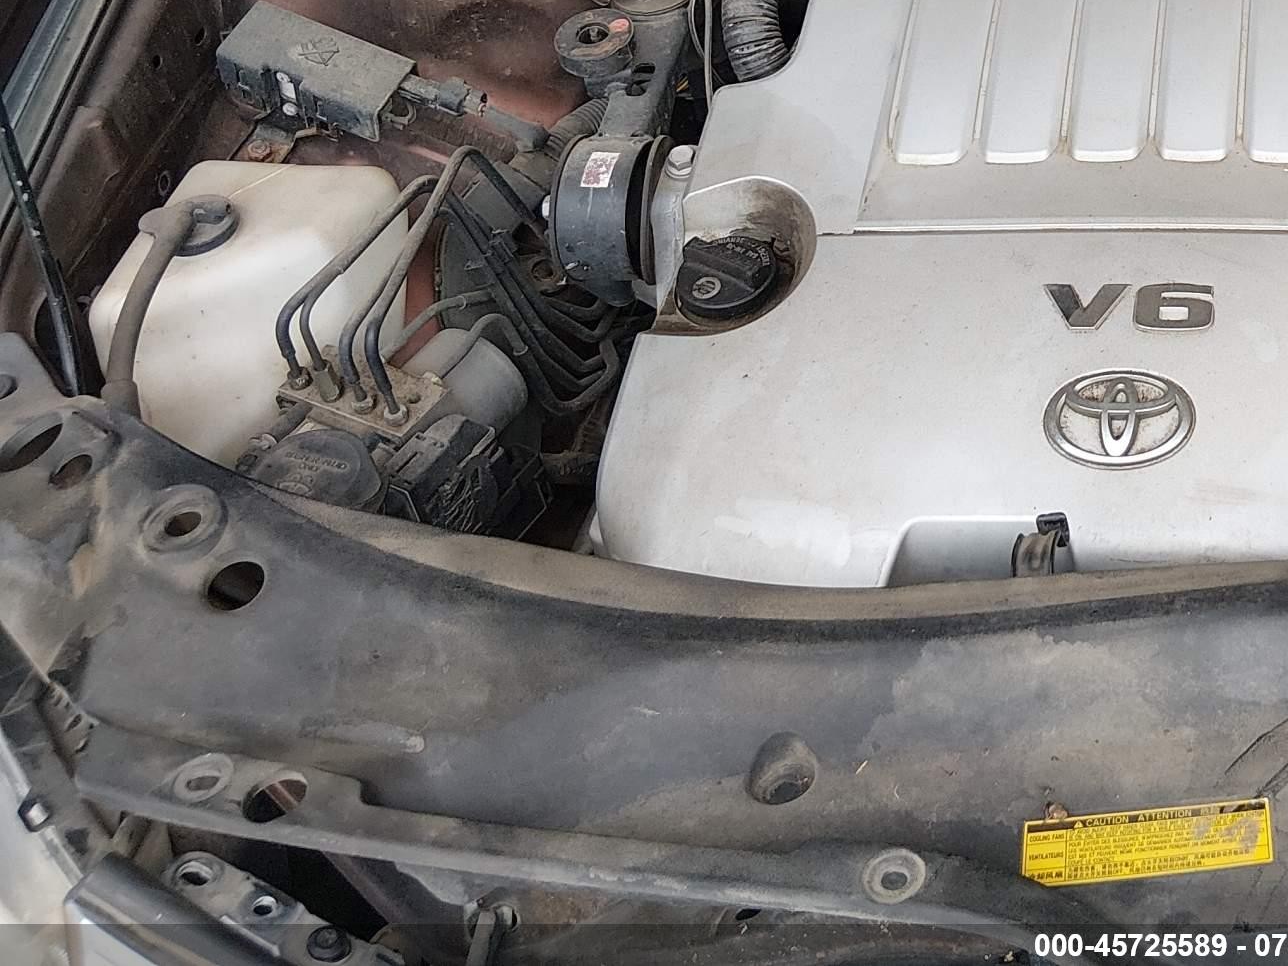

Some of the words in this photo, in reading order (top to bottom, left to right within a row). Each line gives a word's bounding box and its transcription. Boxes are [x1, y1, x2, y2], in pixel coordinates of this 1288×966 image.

[1043, 282, 1215, 333] V6
[1085, 815, 1129, 827] CAUTION
[1137, 809, 1192, 822] ATTENTION
